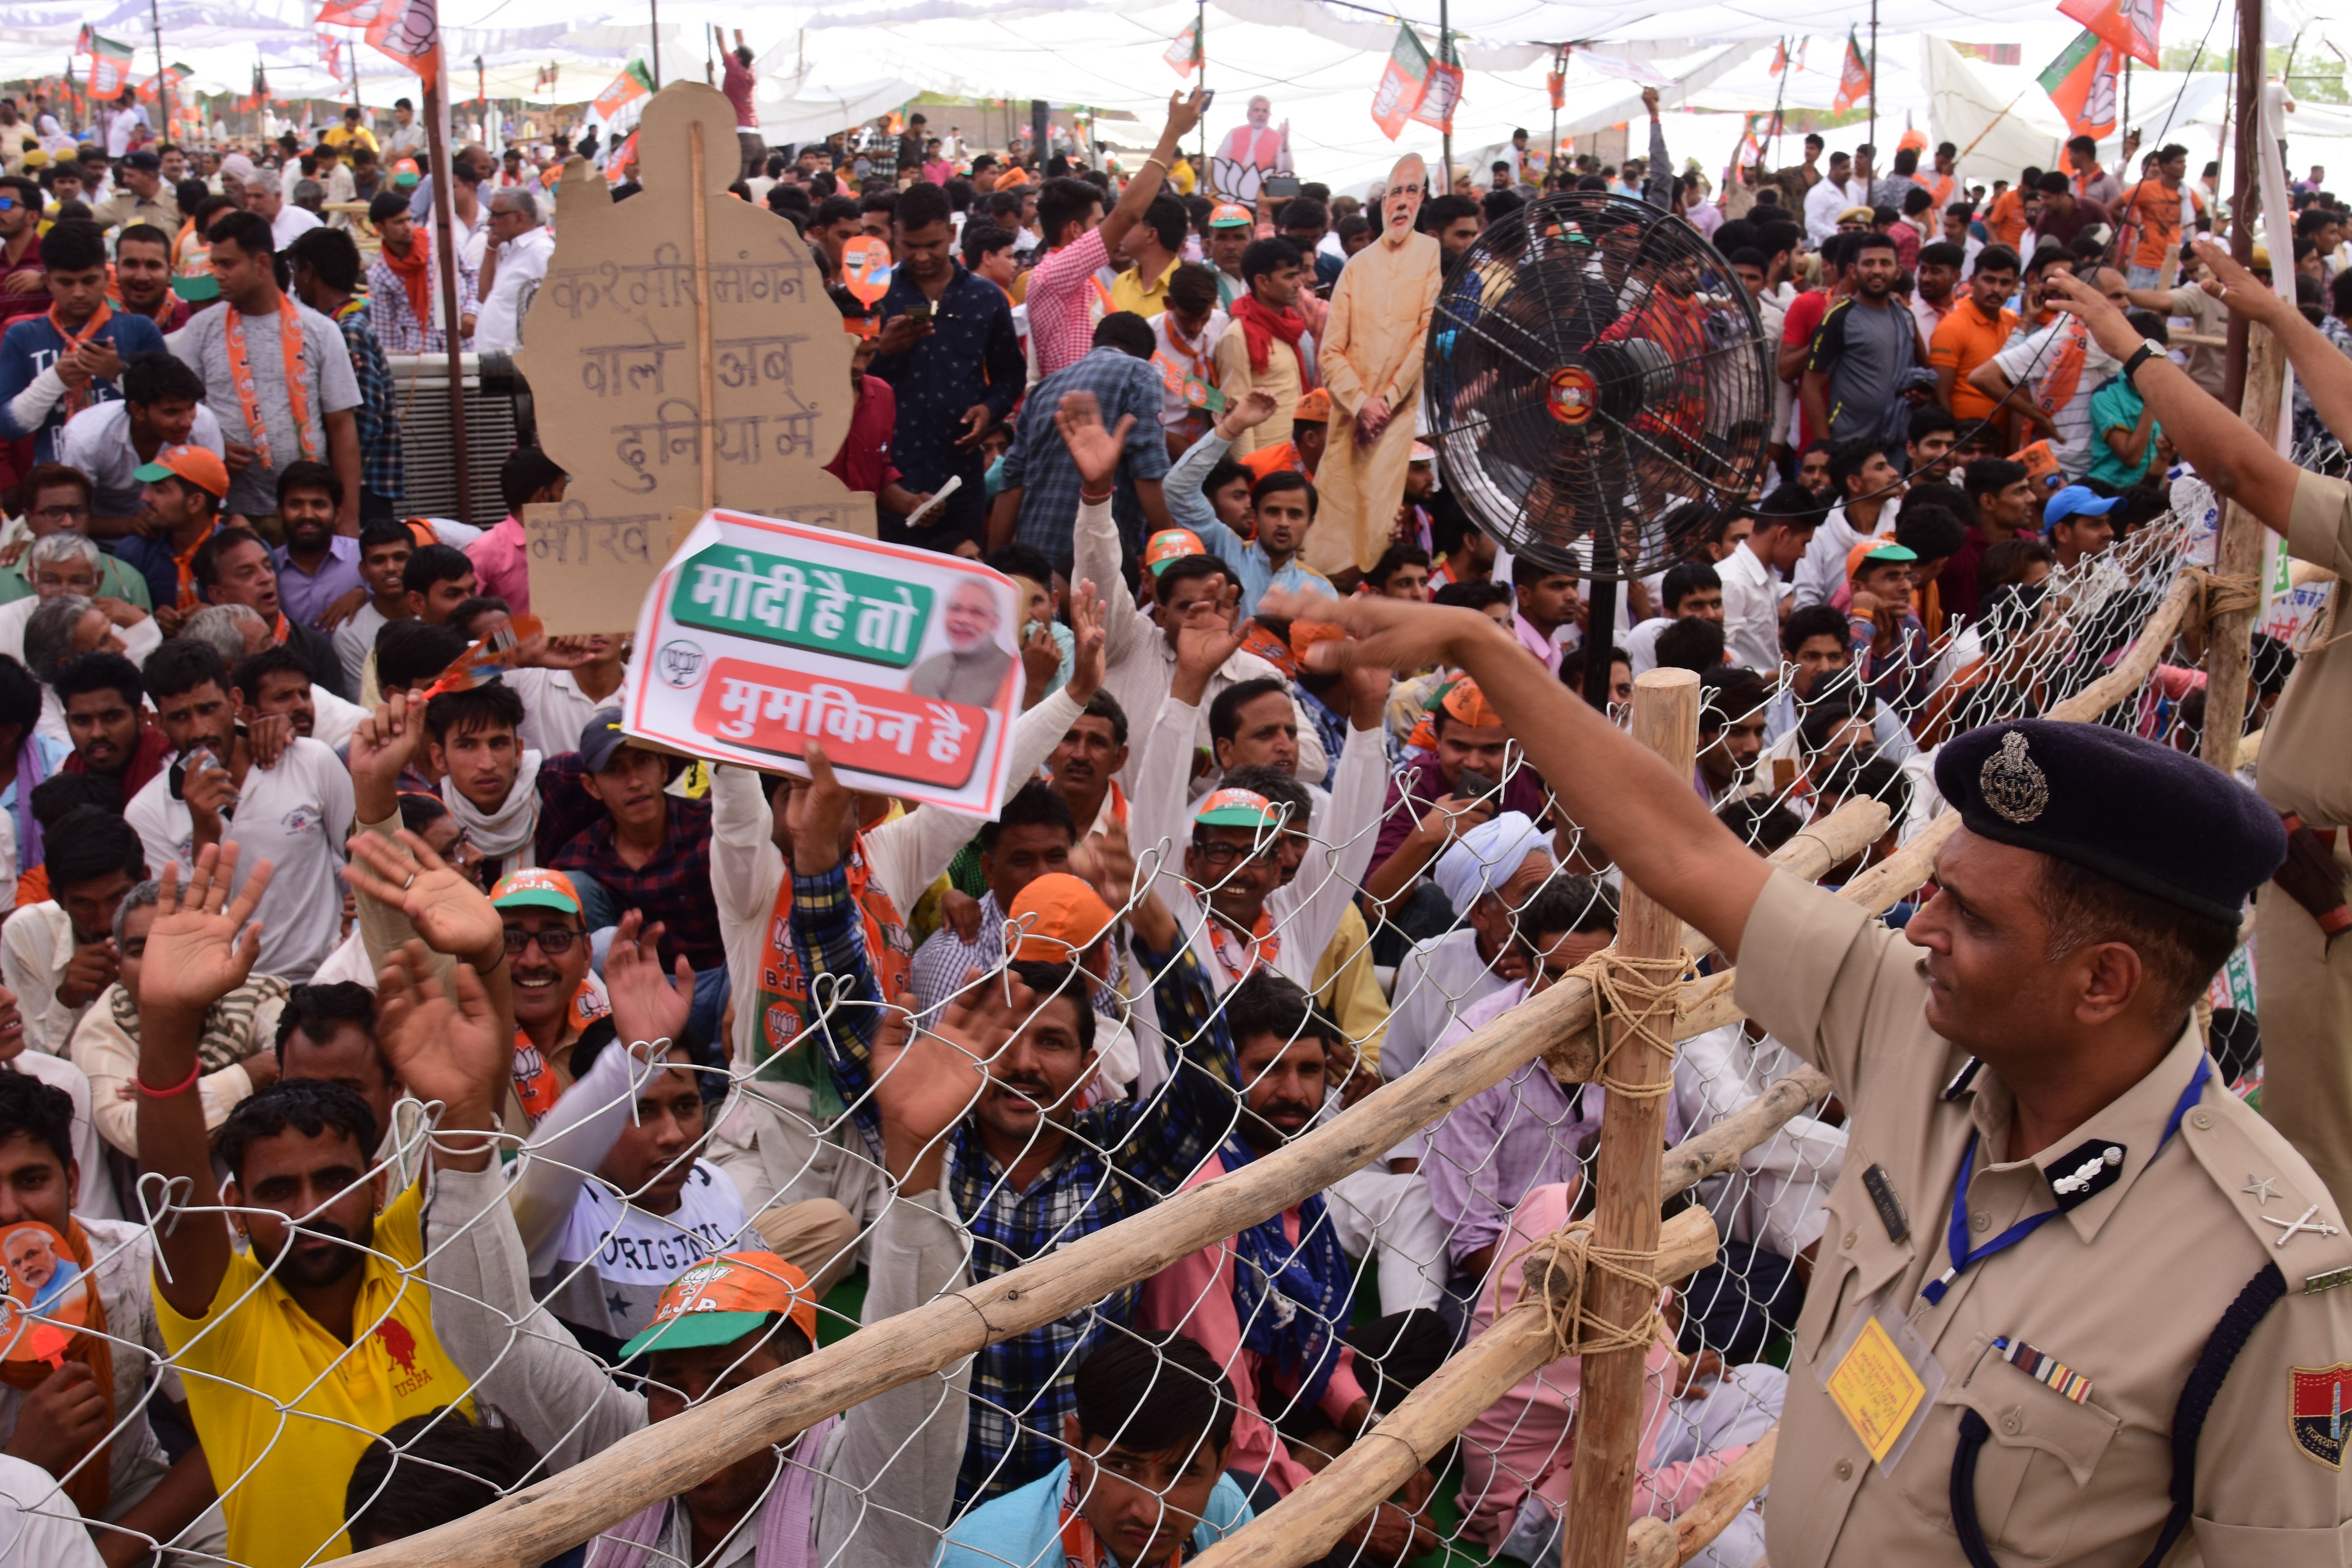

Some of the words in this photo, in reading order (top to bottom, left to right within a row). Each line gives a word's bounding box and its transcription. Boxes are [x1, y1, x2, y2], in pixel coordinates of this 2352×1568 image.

[581, 317, 686, 396] वाले
[715, 334, 810, 387] अब
[773, 388, 821, 457] में
[692, 555, 809, 632] मोदी
[809, 570, 855, 639] है
[855, 586, 920, 655] तो
[716, 677, 922, 756] मुमकिन
[925, 703, 969, 763] है
[394, 1369, 433, 1397] USPA
